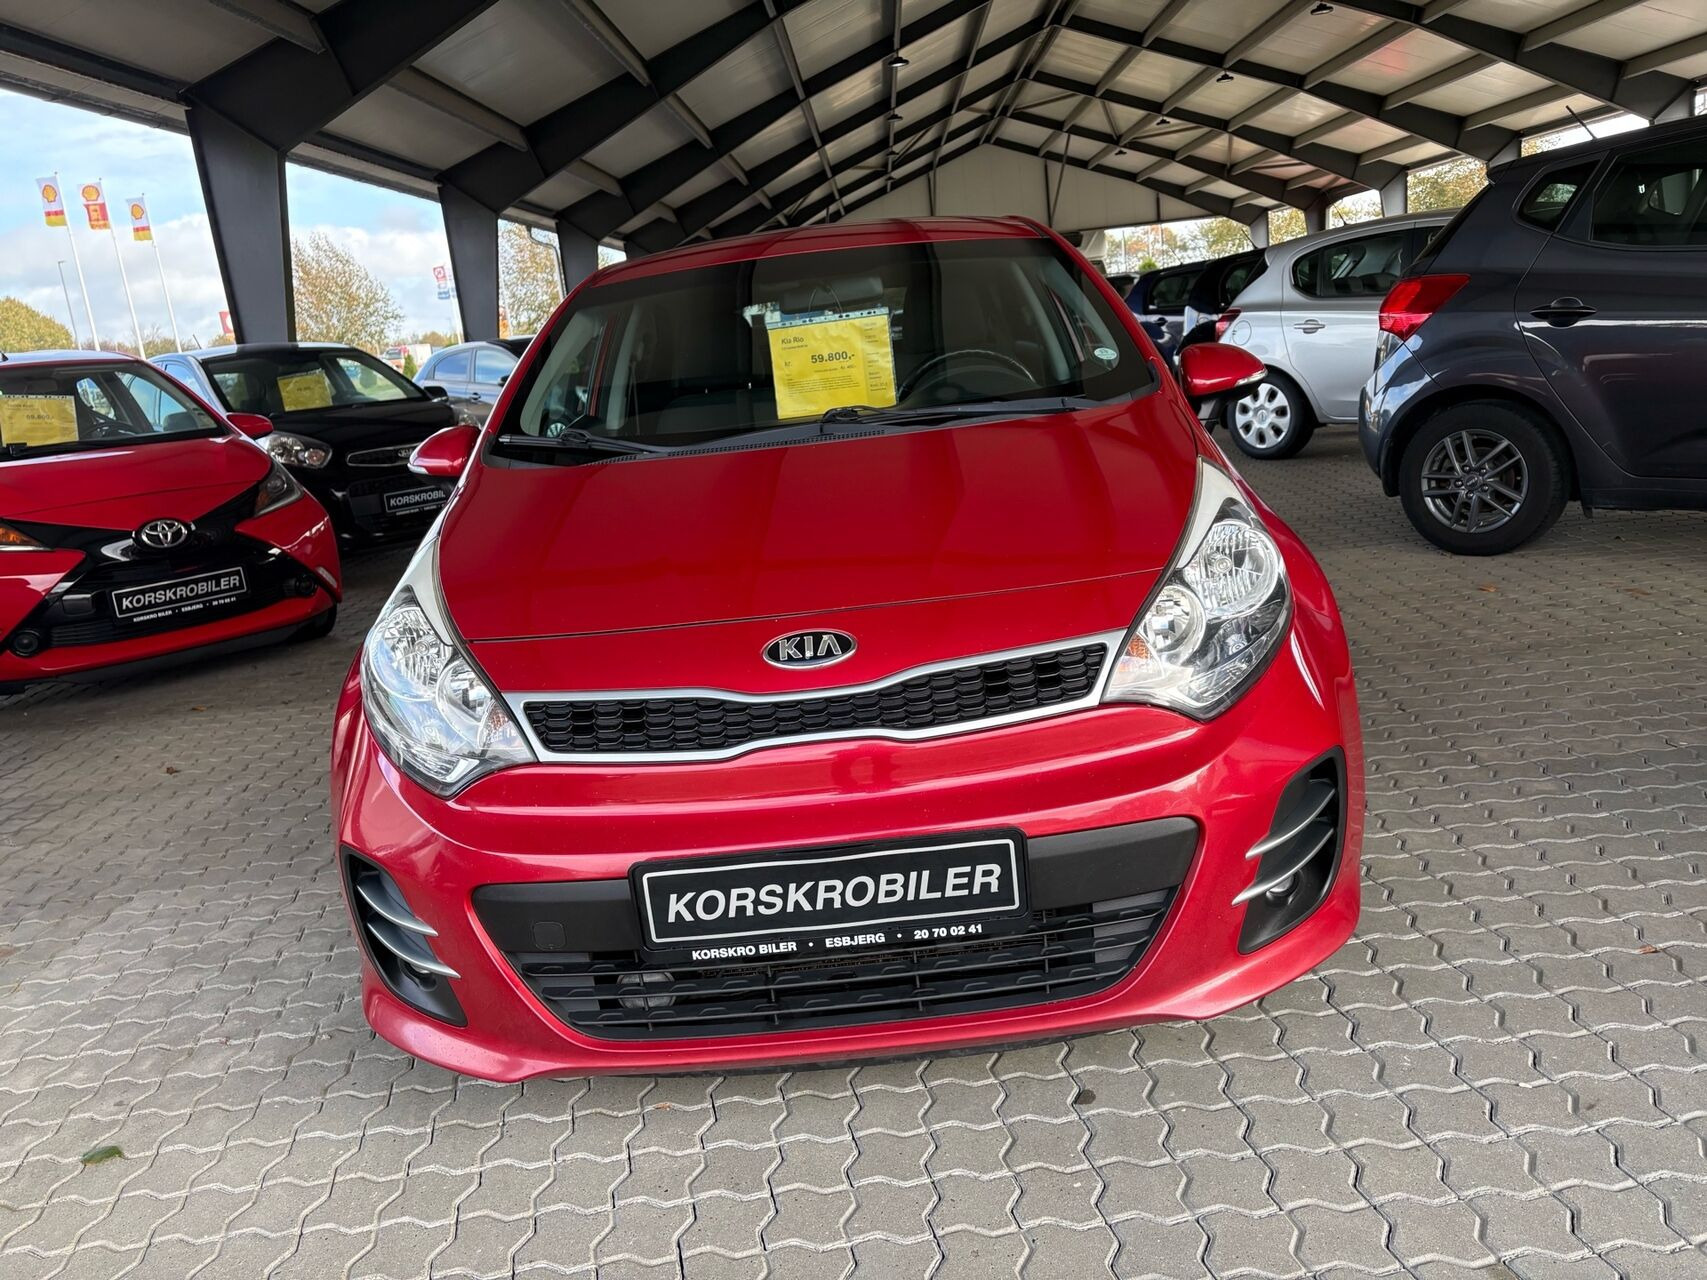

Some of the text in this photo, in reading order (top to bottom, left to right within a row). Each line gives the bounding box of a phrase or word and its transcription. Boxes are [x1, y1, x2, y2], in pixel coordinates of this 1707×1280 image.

[811, 350, 855, 364] 59.800,-
[122, 575, 240, 610] KORSKROBILER
[779, 634, 843, 660] KIA
[667, 863, 1002, 923] KORSKROBILER
[692, 923, 983, 960] KORSKRO BILER ESBJERG 20 70 02 41
